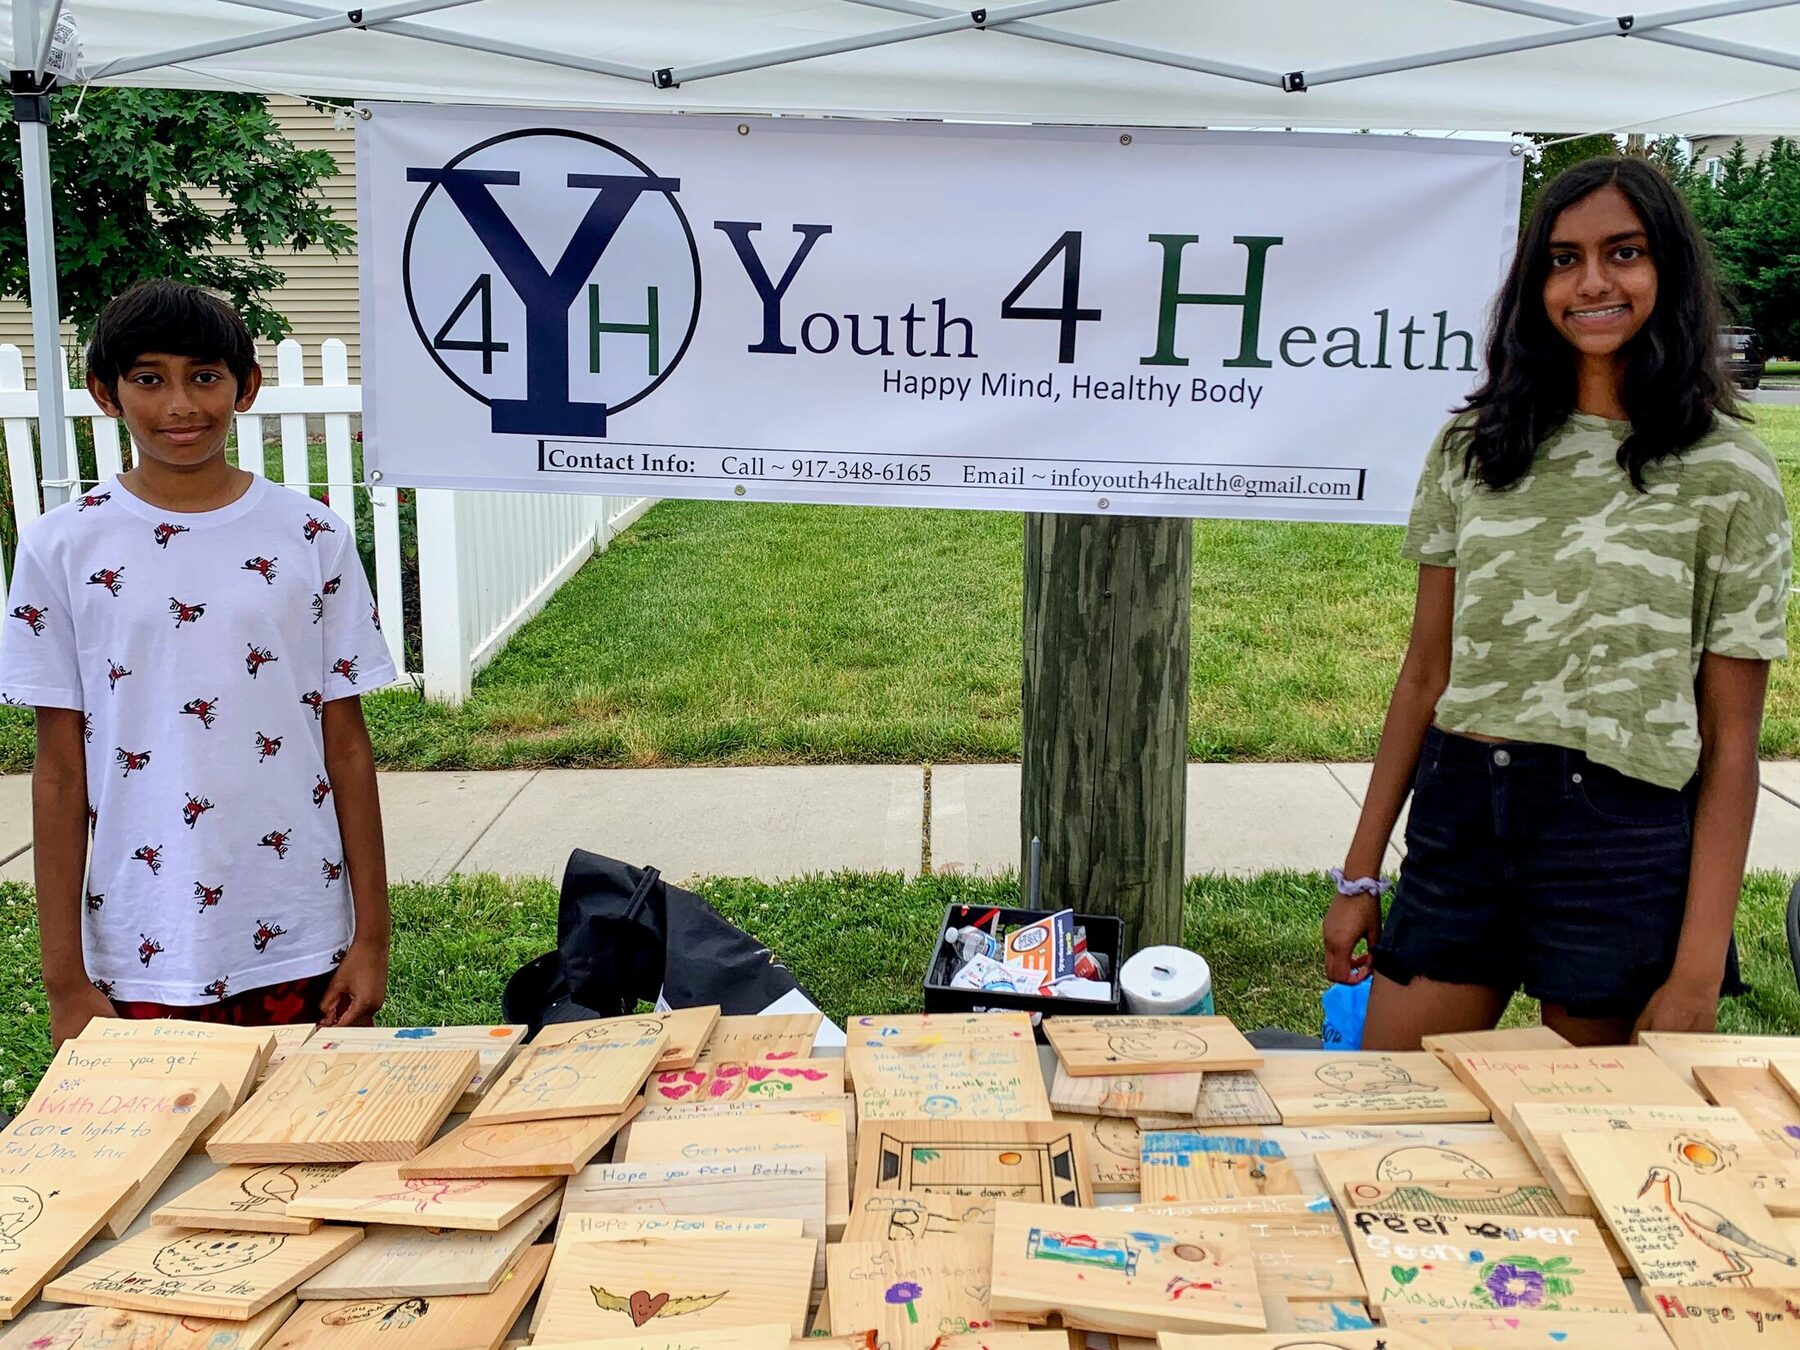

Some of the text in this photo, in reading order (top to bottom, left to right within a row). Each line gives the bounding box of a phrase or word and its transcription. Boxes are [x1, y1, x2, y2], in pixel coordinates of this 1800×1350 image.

[714, 221, 1478, 371] Youth 4 Health
[434, 274, 659, 376] 4 H
[884, 369, 1263, 409] Happy Mind, Healthy Body
[549, 448, 635, 472] Contact
[641, 452, 696, 473] Info:
[721, 456, 765, 477] Call
[792, 458, 932, 482] 917-348-6165
[962, 465, 1025, 486] Email
[1051, 469, 1352, 498] infoyouth4health@gmail.com
[67, 1050, 200, 1073] hope you get
[1467, 1058, 1529, 1075] Hope
[1543, 1062, 1580, 1075] you
[863, 1087, 887, 1098] God
[82, 1121, 126, 1141] light
[129, 1122, 151, 1137] to
[682, 1143, 719, 1158] Get
[727, 1144, 761, 1153] well
[602, 1170, 648, 1184] Hope
[663, 1170, 689, 1182] you
[752, 1164, 812, 1176] Better
[956, 1188, 972, 1196] the
[1012, 1187, 1027, 1197] of
[1355, 1212, 1450, 1237] feel
[849, 1267, 887, 1280] Get
[193, 1280, 216, 1292] to
[226, 1280, 256, 1295] the
[1655, 1294, 1735, 1323] Hope
